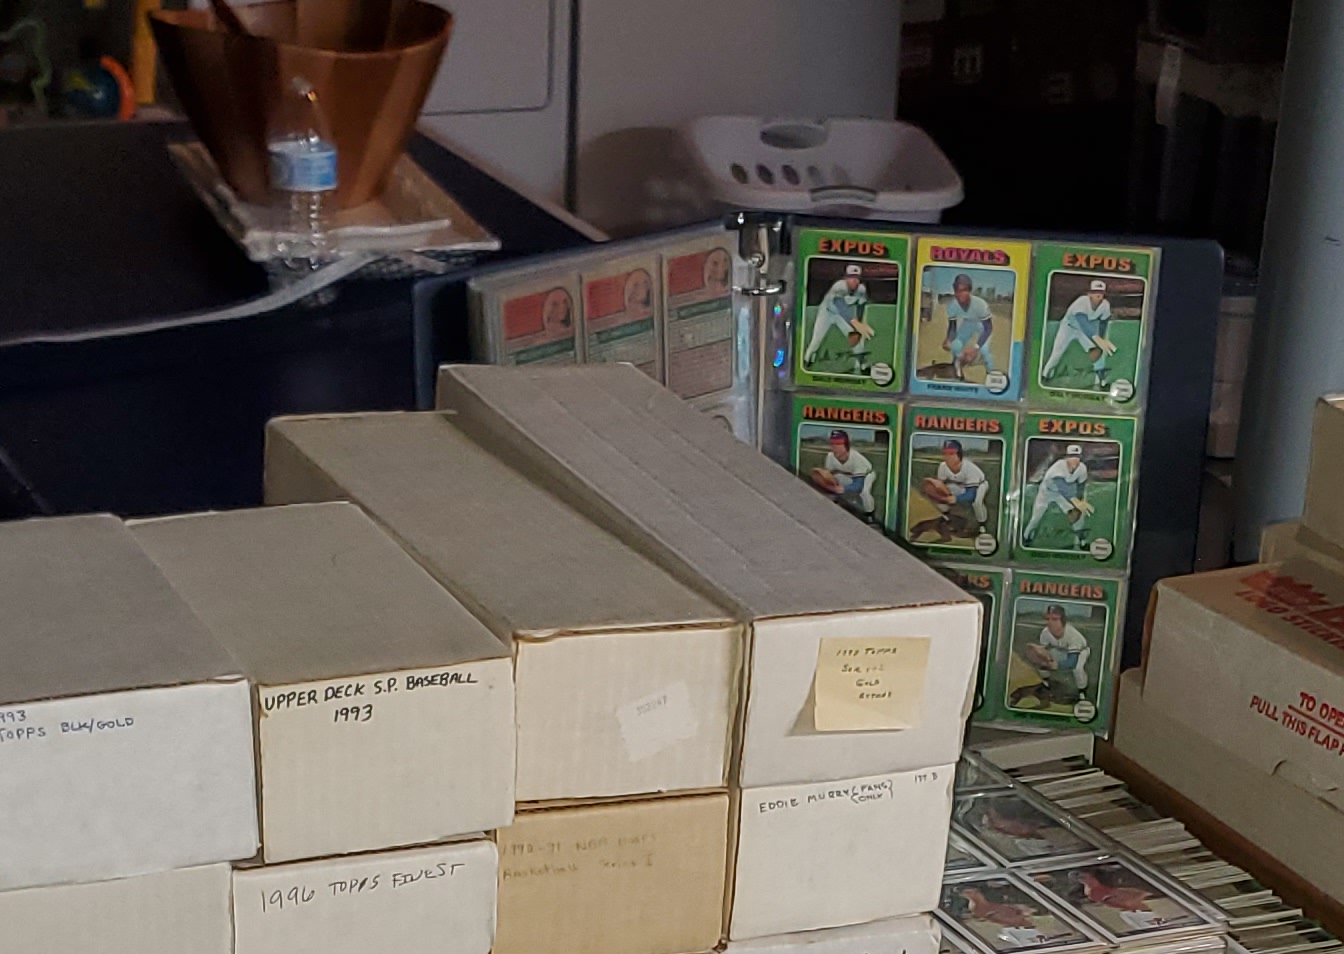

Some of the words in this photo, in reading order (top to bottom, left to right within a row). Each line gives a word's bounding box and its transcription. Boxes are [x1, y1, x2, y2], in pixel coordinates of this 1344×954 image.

[818, 238, 886, 257] EXPOS
[930, 245, 1006, 265] ROYALS
[1062, 251, 1132, 272] EXPOS
[802, 404, 887, 424] RANGERS
[916, 414, 1001, 433] RANGERS
[1039, 418, 1106, 436] EXPOS
[1019, 579, 1104, 599] RANGERS
[264, 688, 318, 712] UPPER
[323, 683, 365, 702] DECK
[405, 672, 478, 692] BASEBALL
[1299, 691, 1317, 712] TO
[334, 704, 374, 724] 1993
[1249, 694, 1279, 722] PULL
[1282, 711, 1307, 736] THIS
[1307, 726, 1340, 751] FLAP
[60, 717, 134, 734] BLK/GOLD
[758, 799, 799, 813] EDDIE
[260, 886, 316, 913] 1996
